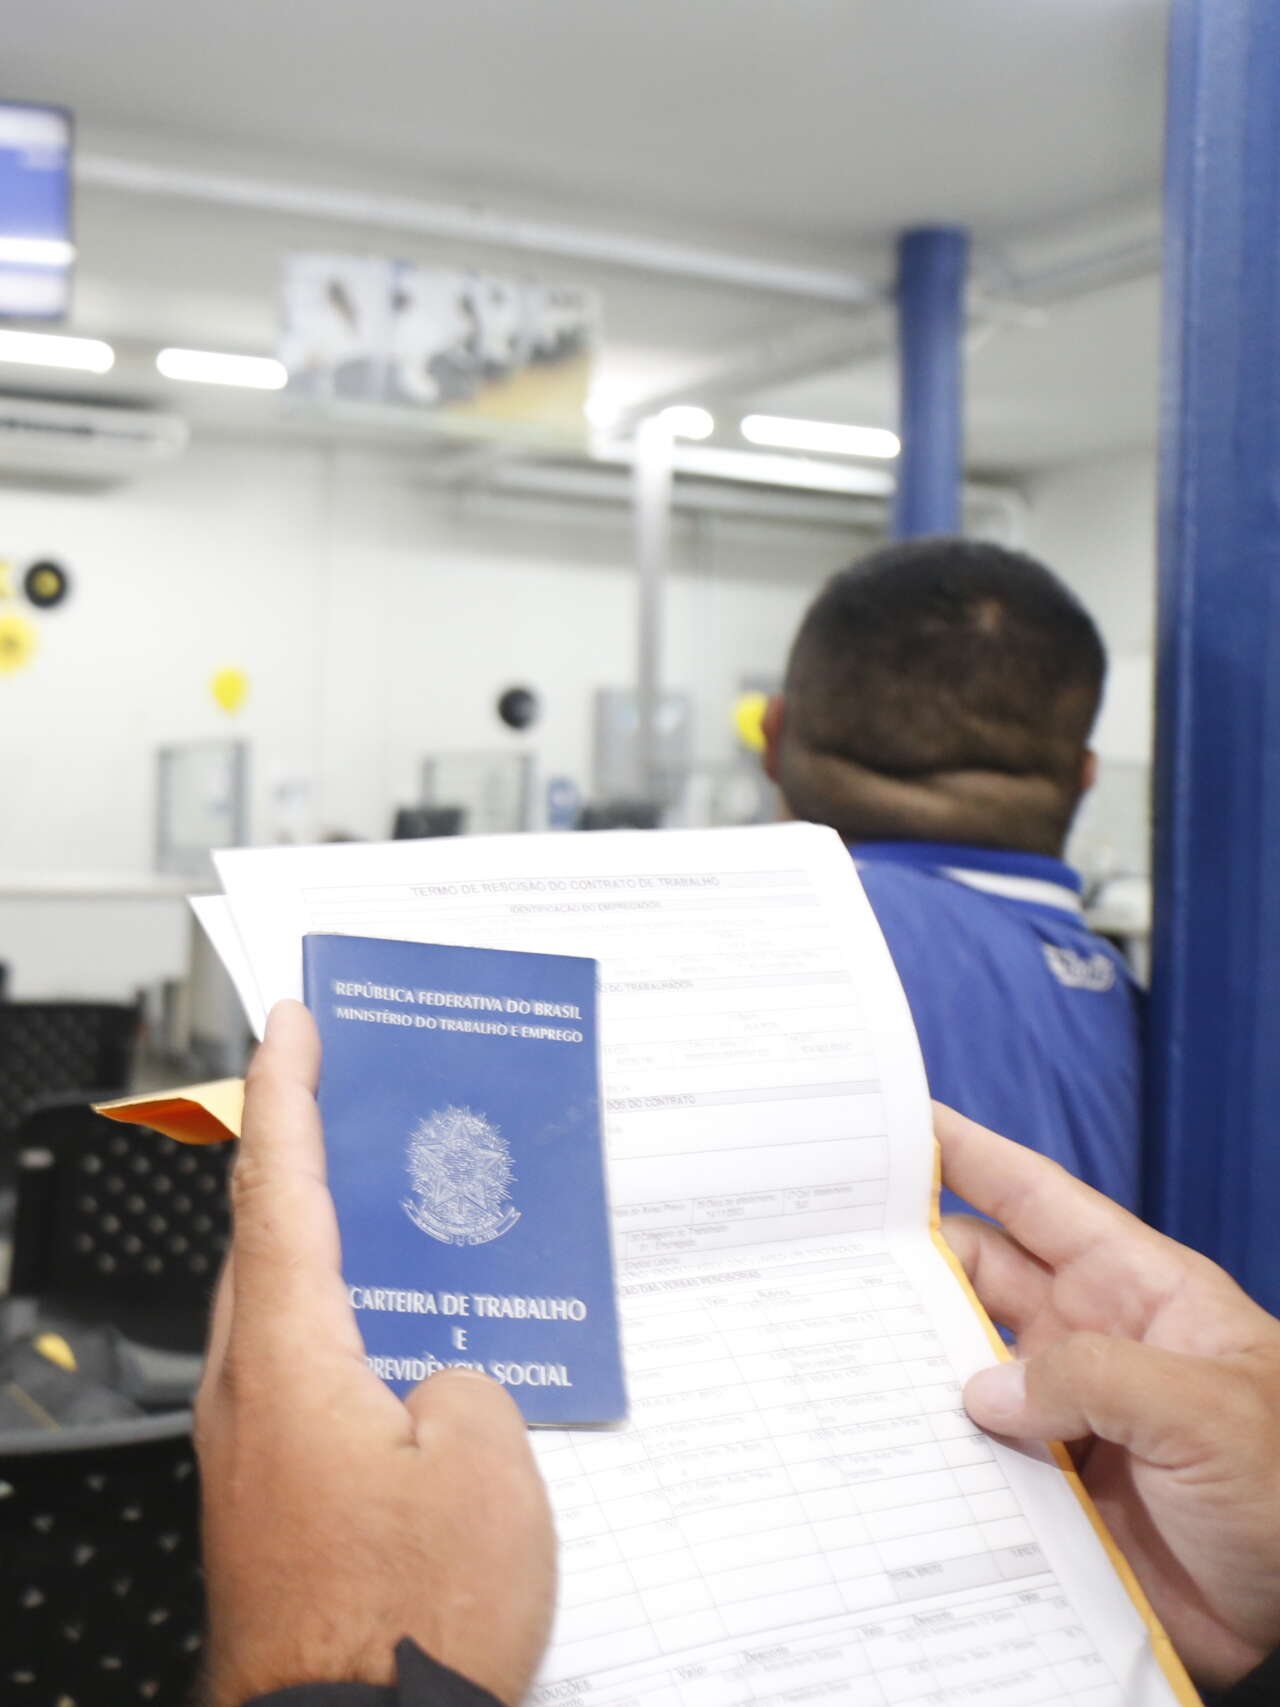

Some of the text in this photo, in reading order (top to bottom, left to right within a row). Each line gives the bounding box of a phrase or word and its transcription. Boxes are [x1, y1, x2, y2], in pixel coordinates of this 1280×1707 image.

[411, 885, 458, 896] TERMO
[462, 884, 480, 894] DE
[548, 880, 567, 891] DO
[570, 879, 637, 891] CONTRATO
[638, 878, 656, 888] DE
[657, 876, 720, 888] TRABALHO
[335, 981, 583, 1020] REPÚBLICA FEDERATIVA DO BRASIL
[336, 1007, 583, 1043] MINISTÉRIO DO TRABALHO E EMPREGO
[350, 1287, 587, 1321] CARTEIRA DE TRABALHO
[455, 1327, 469, 1350] E
[491, 1363, 572, 1387] SOCIAL
